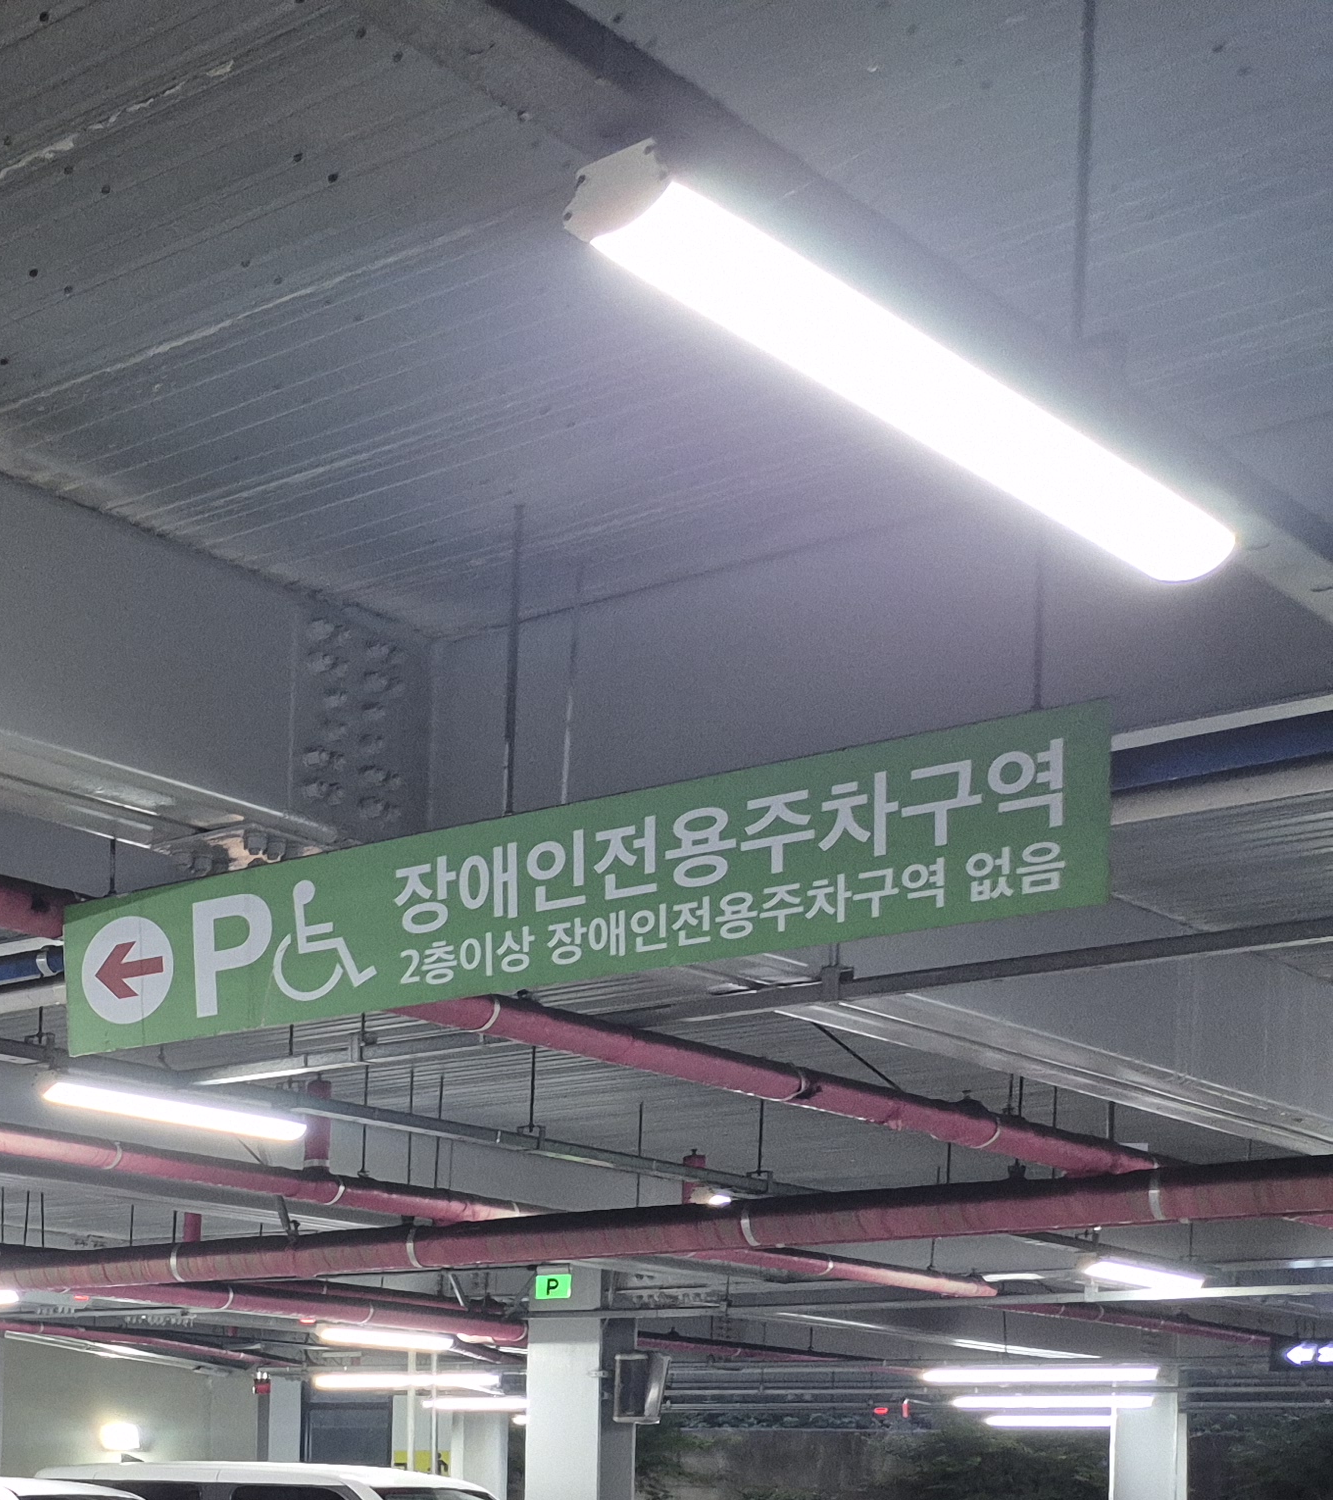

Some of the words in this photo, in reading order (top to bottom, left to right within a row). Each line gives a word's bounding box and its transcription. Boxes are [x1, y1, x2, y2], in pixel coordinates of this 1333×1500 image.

[394, 738, 1064, 934] 장애인전용주차구역
[192, 893, 273, 1021] P
[399, 924, 535, 985] 2층이상
[546, 857, 946, 965] 장애인전용주차구역
[965, 841, 1066, 902] 없음
[546, 1278, 559, 1296] P
